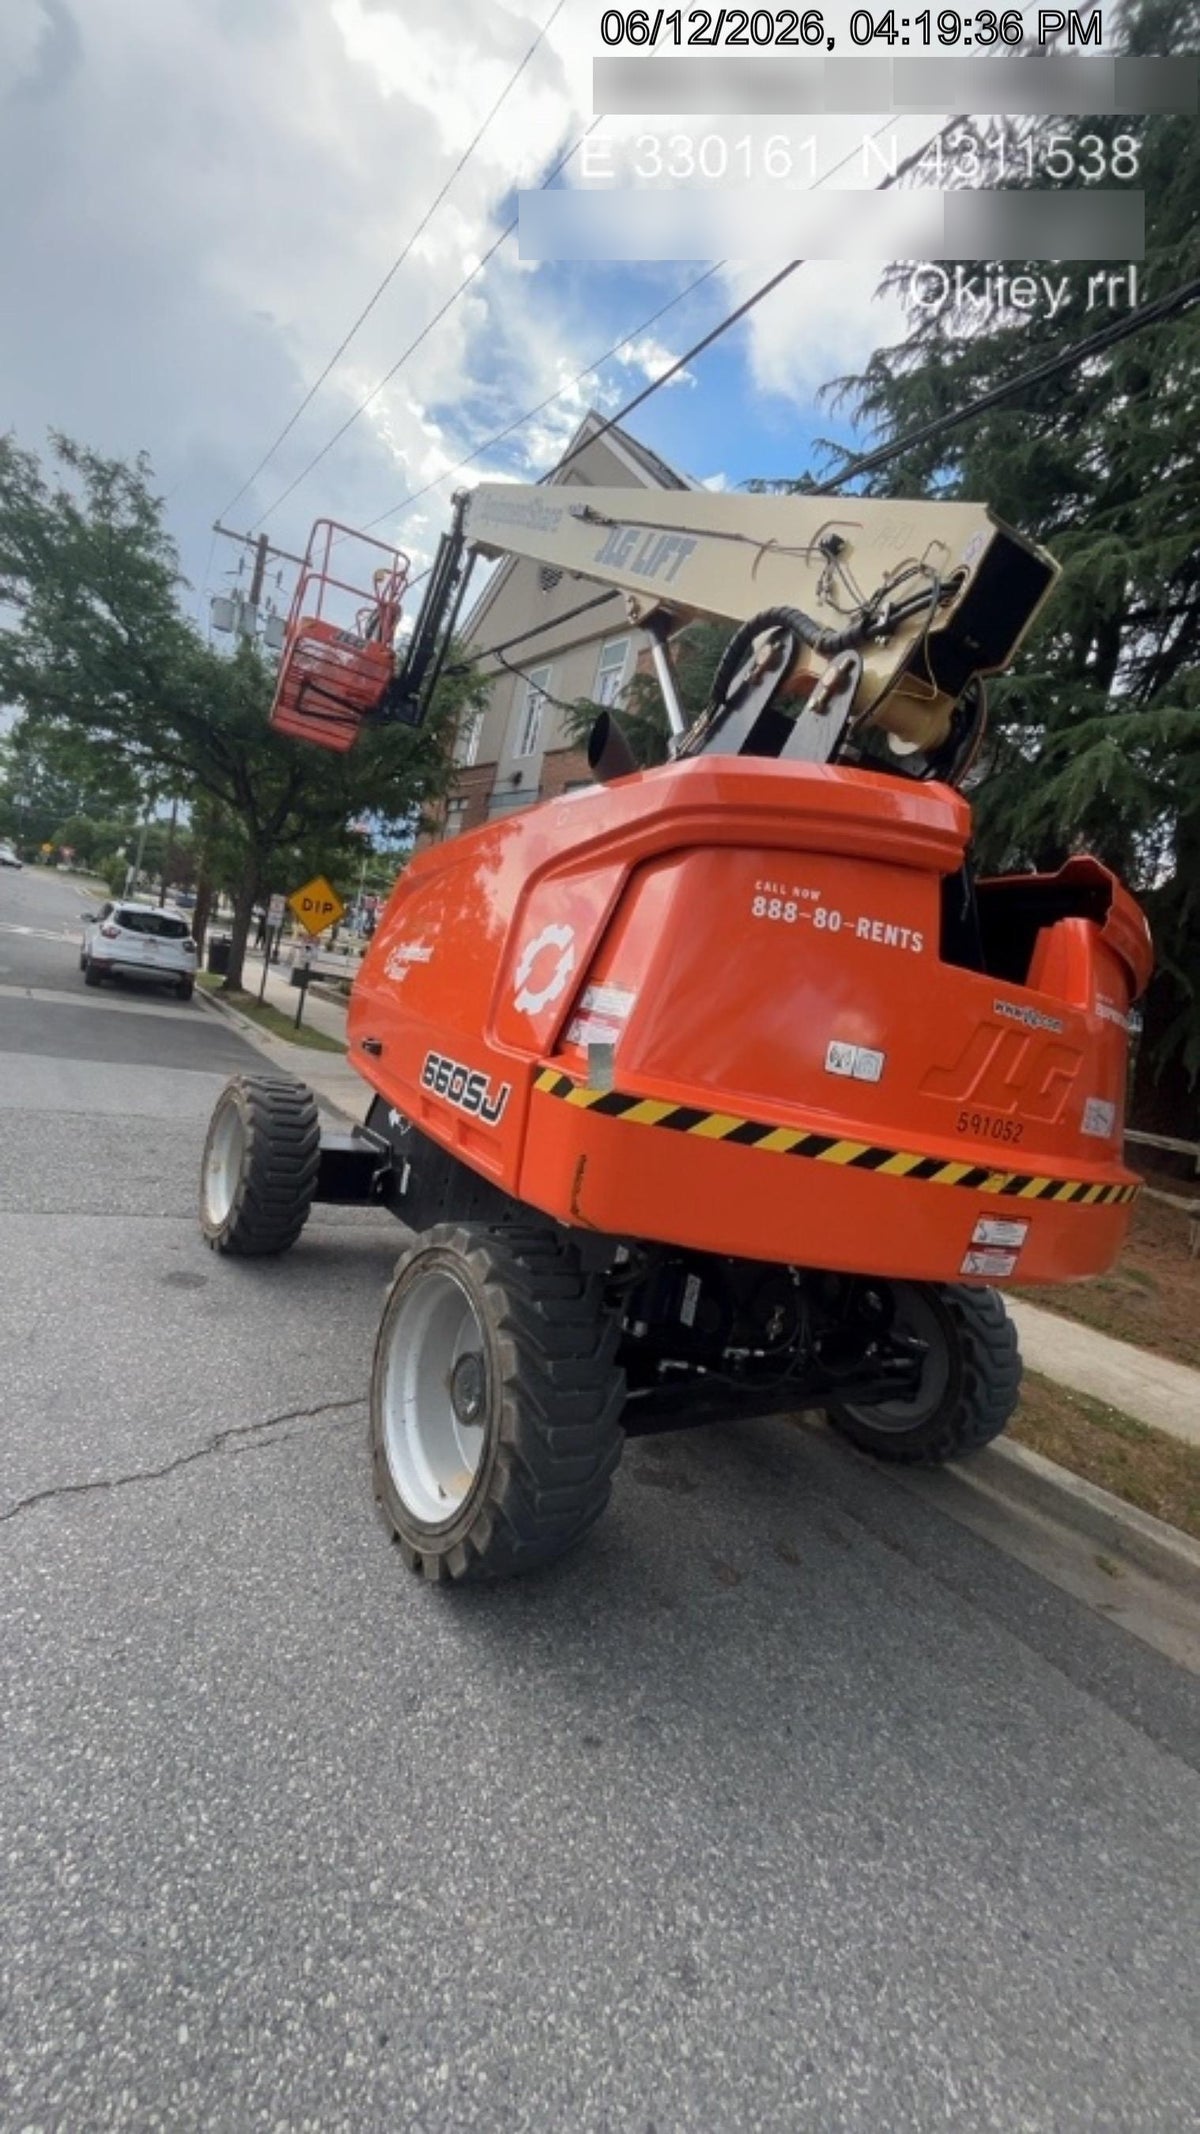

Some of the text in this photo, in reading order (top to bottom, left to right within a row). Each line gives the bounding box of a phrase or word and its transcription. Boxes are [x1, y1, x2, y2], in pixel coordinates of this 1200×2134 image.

[630, 532, 699, 582] LIFT
[303, 898, 333, 914] DIP
[754, 880, 821, 901] CALL NOW
[752, 896, 924, 953] 888-80-RENTS
[420, 1050, 512, 1126] 660SJ
[917, 1021, 1086, 1124] JLG
[956, 1112, 1025, 1144] 591052
